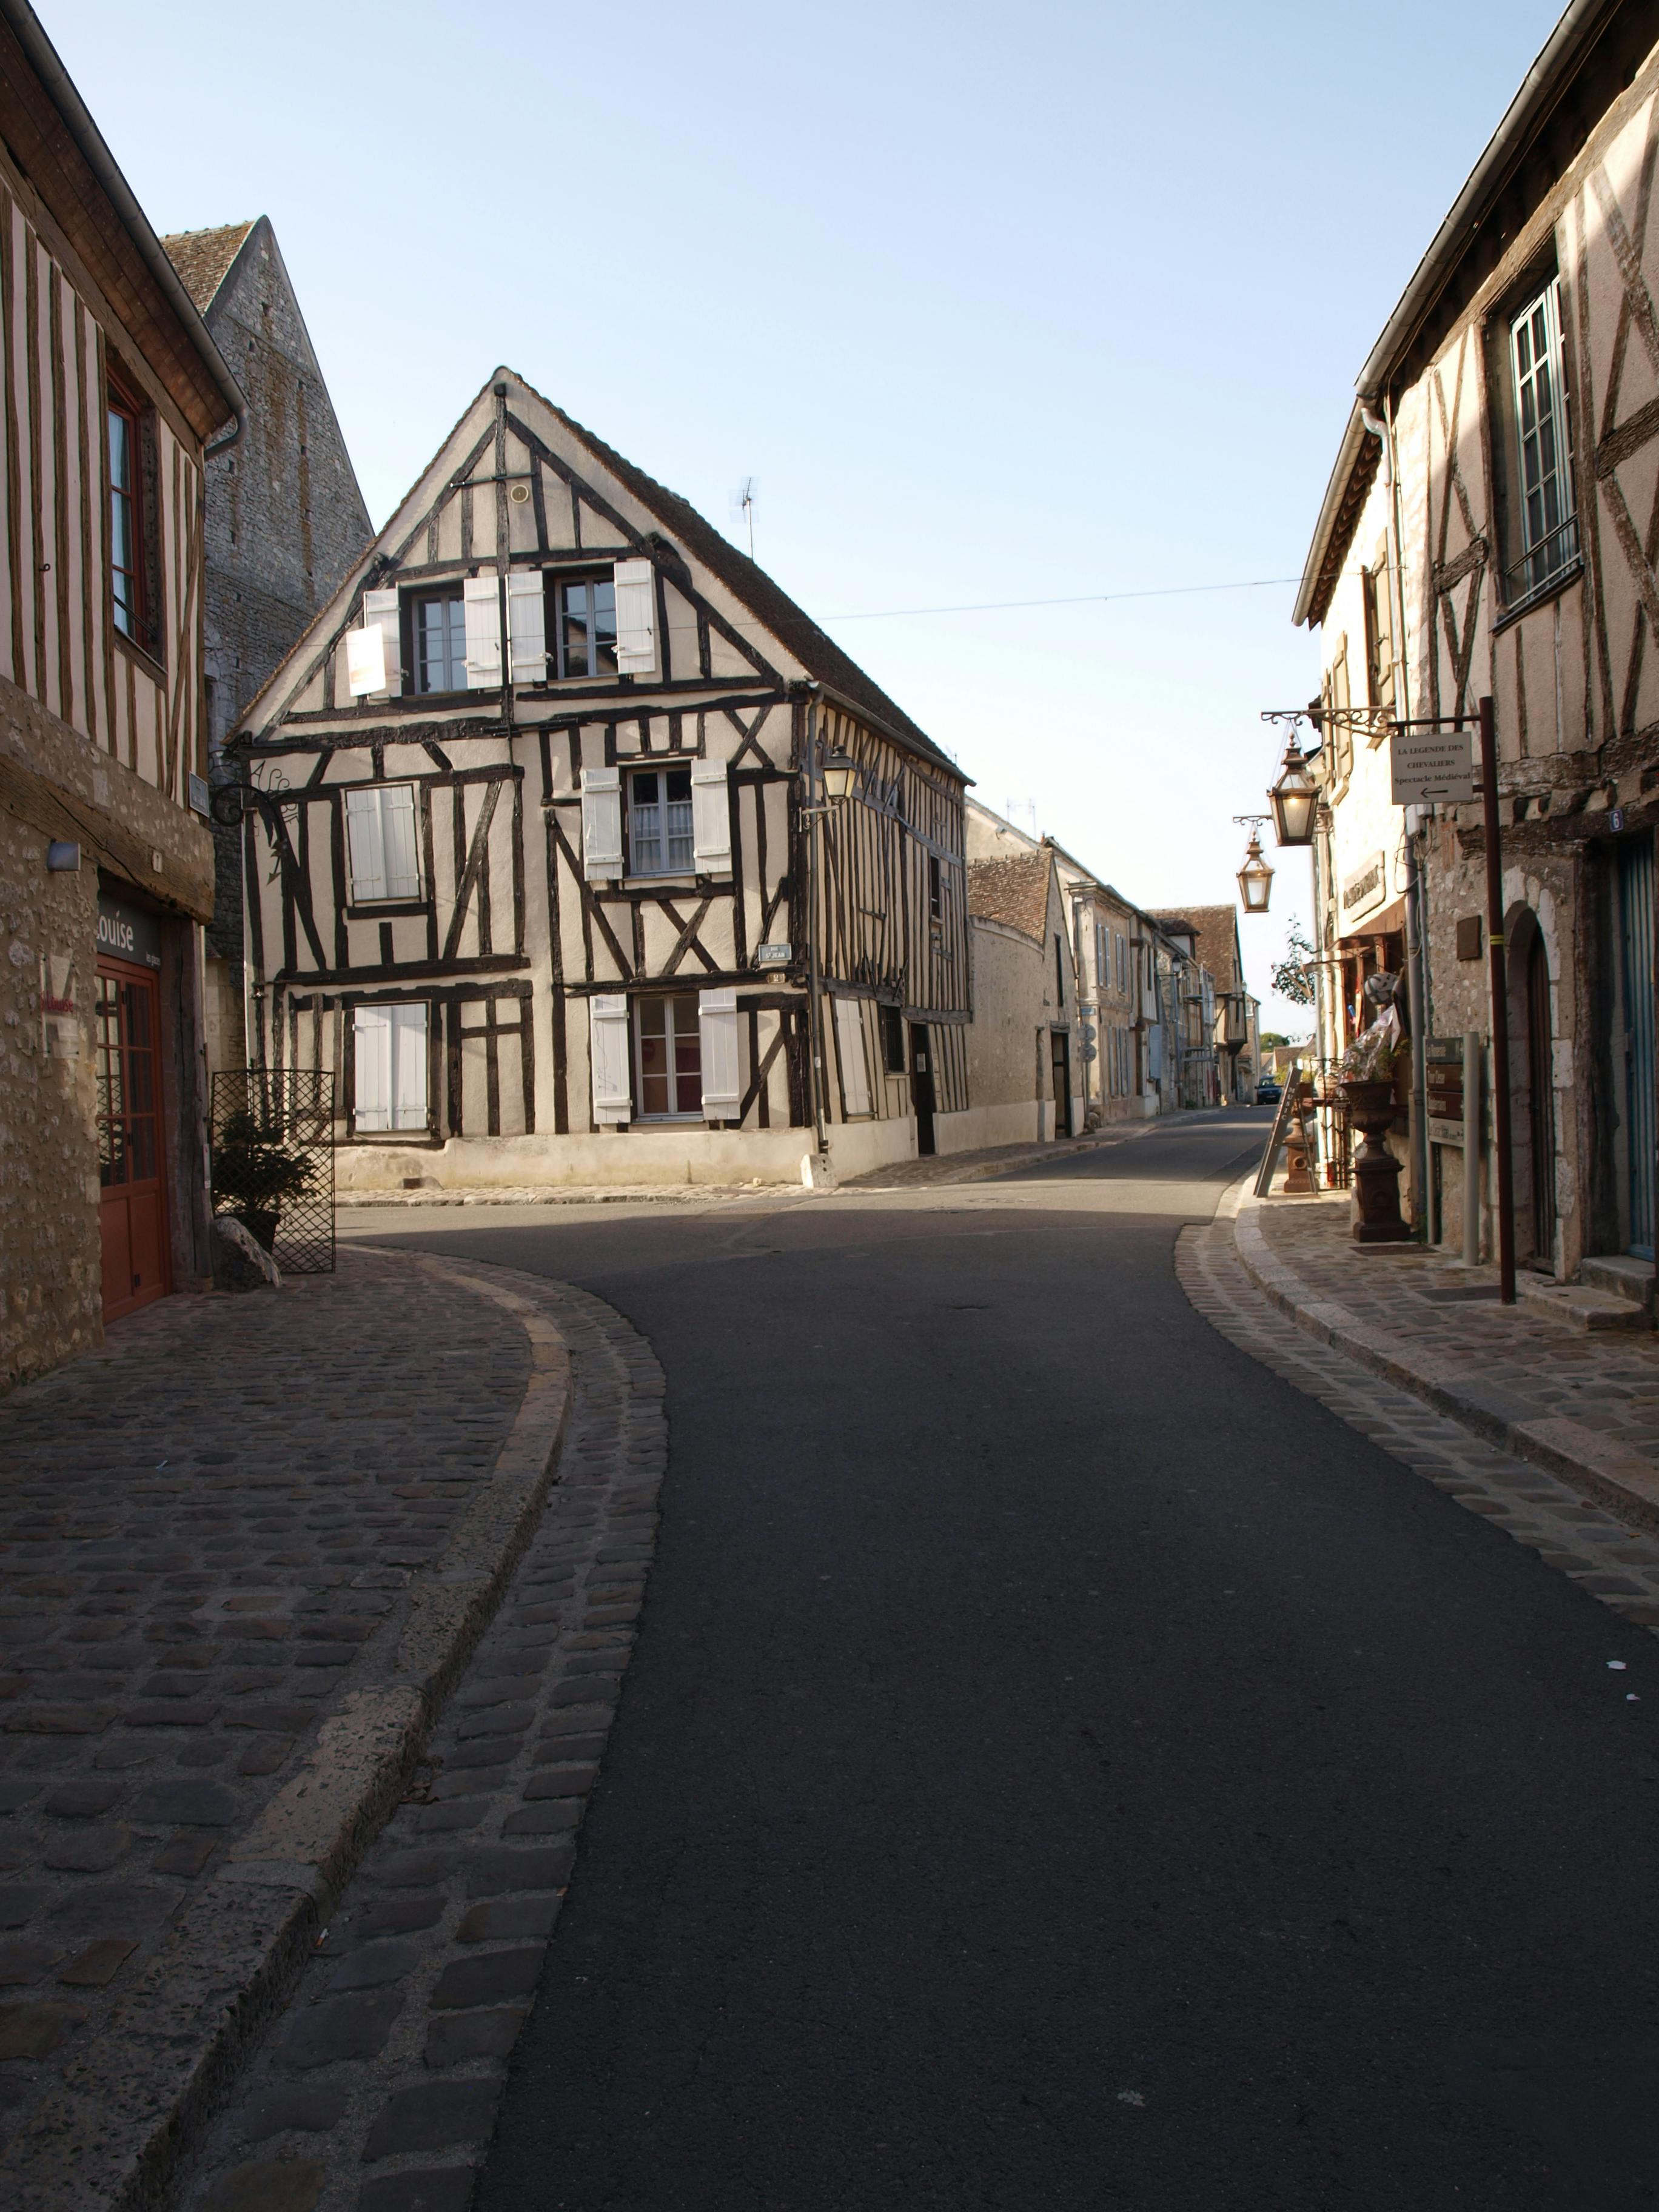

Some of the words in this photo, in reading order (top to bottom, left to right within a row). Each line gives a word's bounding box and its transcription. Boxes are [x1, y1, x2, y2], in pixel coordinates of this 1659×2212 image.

[1410, 746, 1446, 754] LEGENDE
[1407, 759, 1455, 769] CHEVALIERS
[1395, 776, 1432, 785] Spectacle
[1435, 773, 1470, 782] Médiéval
[1613, 813, 1620, 828] 6
[96, 910, 134, 951] ouise
[1281, 1087, 1296, 1120] MUSIC
